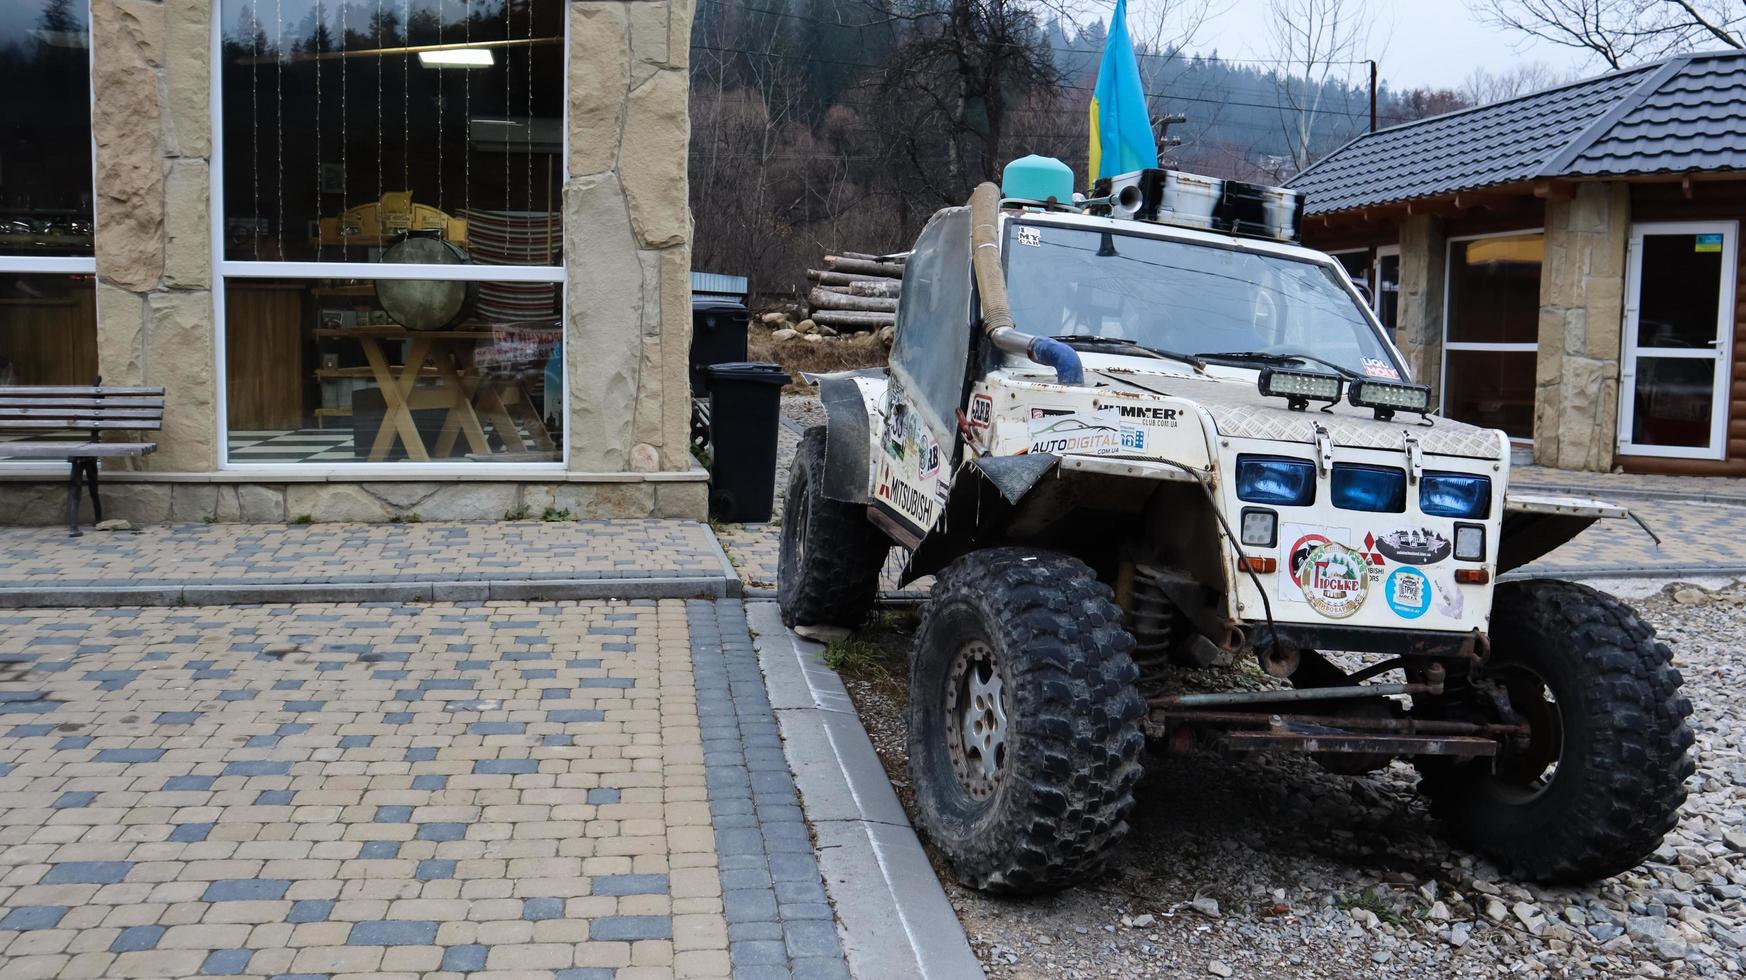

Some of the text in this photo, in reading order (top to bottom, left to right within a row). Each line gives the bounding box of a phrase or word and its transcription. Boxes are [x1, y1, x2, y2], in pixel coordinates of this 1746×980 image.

[1020, 233, 1039, 241] MY
[974, 400, 991, 423] ARB
[1031, 433, 1119, 453] AUTODIGITAL
[890, 476, 934, 527] MITSUBISHI
